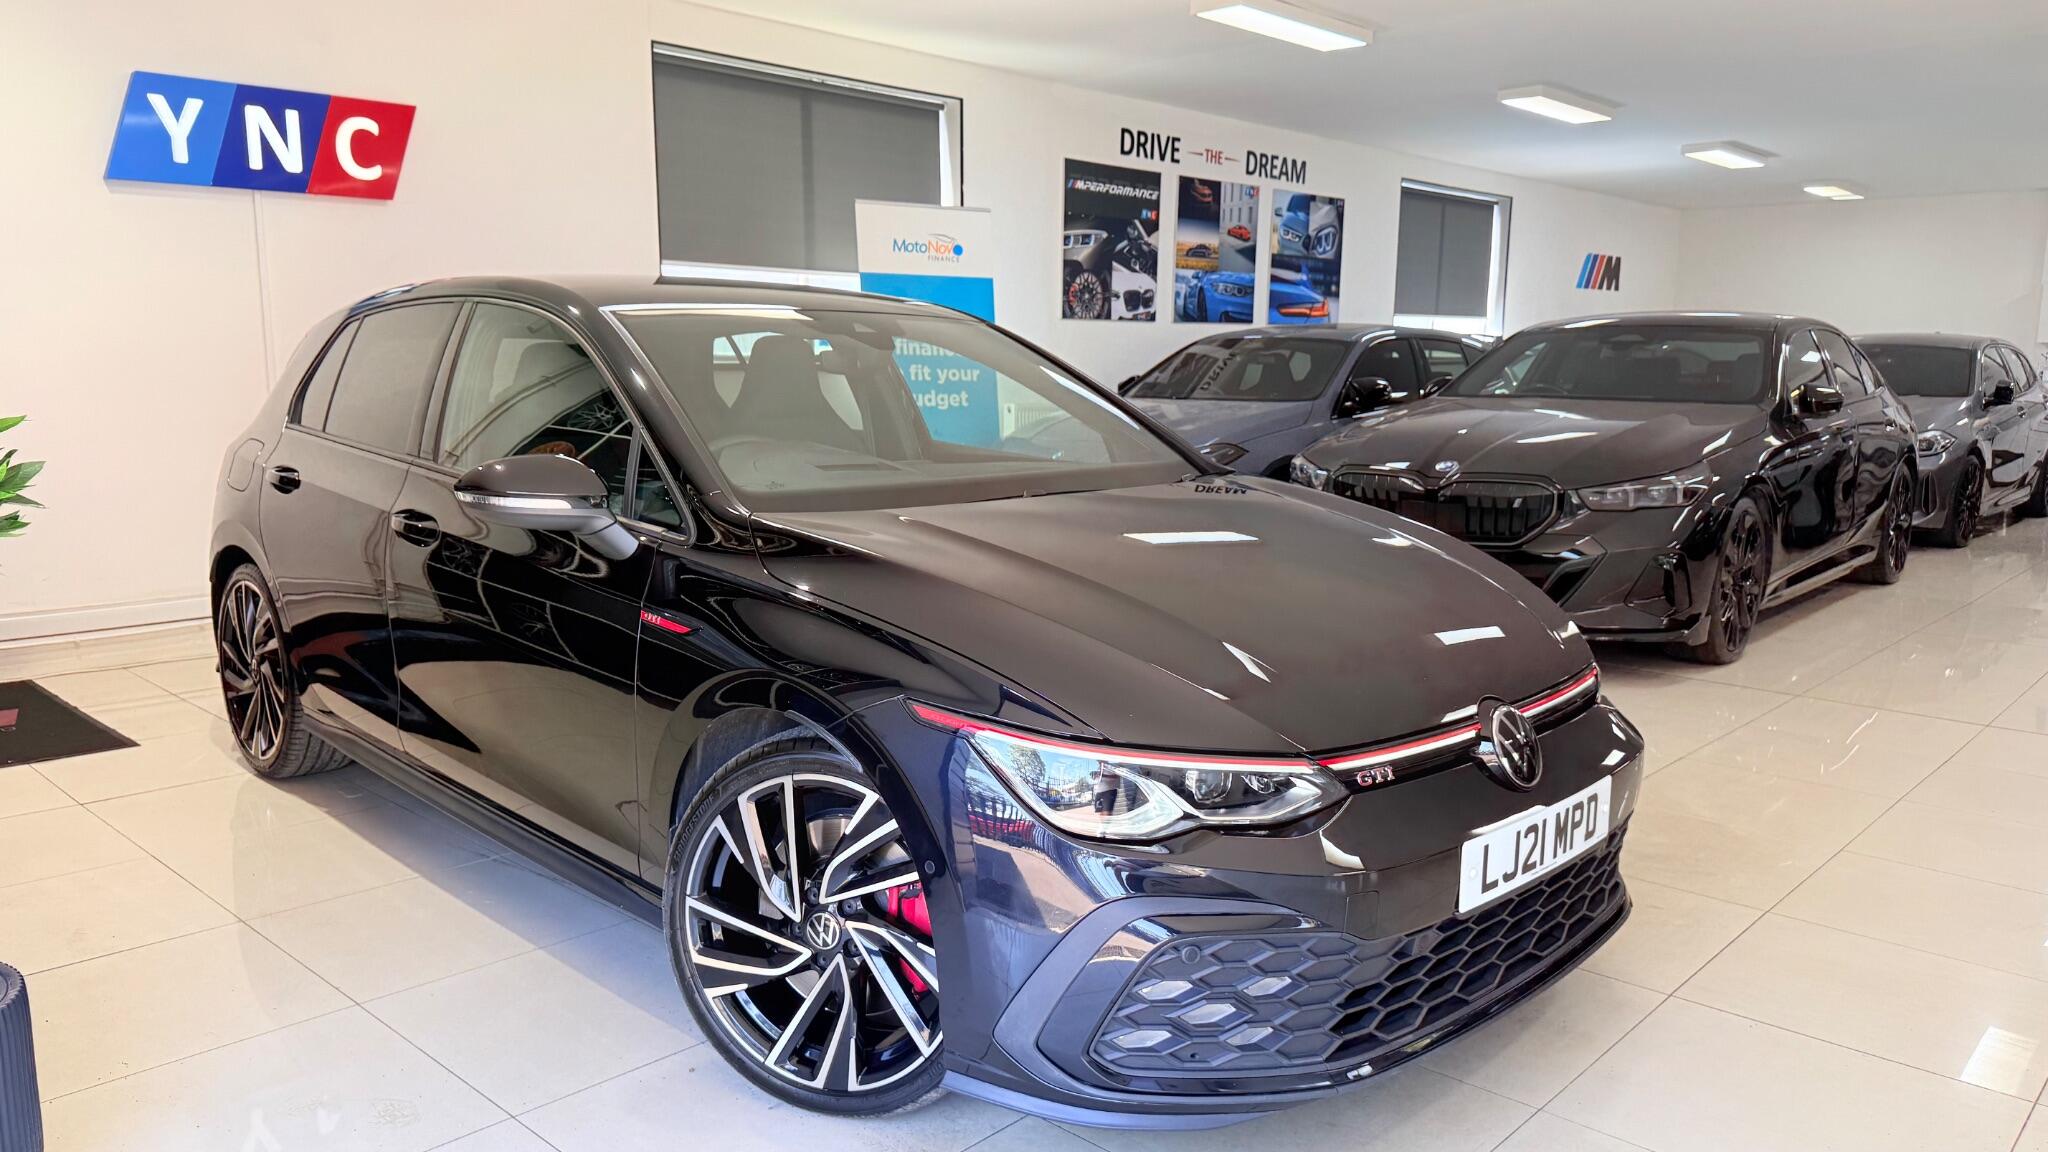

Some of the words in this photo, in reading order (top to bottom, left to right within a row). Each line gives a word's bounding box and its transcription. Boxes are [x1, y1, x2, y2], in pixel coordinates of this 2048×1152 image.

[146, 92, 383, 181] YNC
[1120, 127, 1181, 164] DRIVE
[1245, 150, 1307, 185] DREAM
[927, 255, 960, 263] FINANCE
[909, 364, 931, 381] fit
[936, 368, 980, 384] your
[913, 390, 968, 410] udget
[1356, 765, 1396, 786] GTI
[1481, 818, 1547, 894] LJ21
[1552, 792, 1599, 860] MPD
